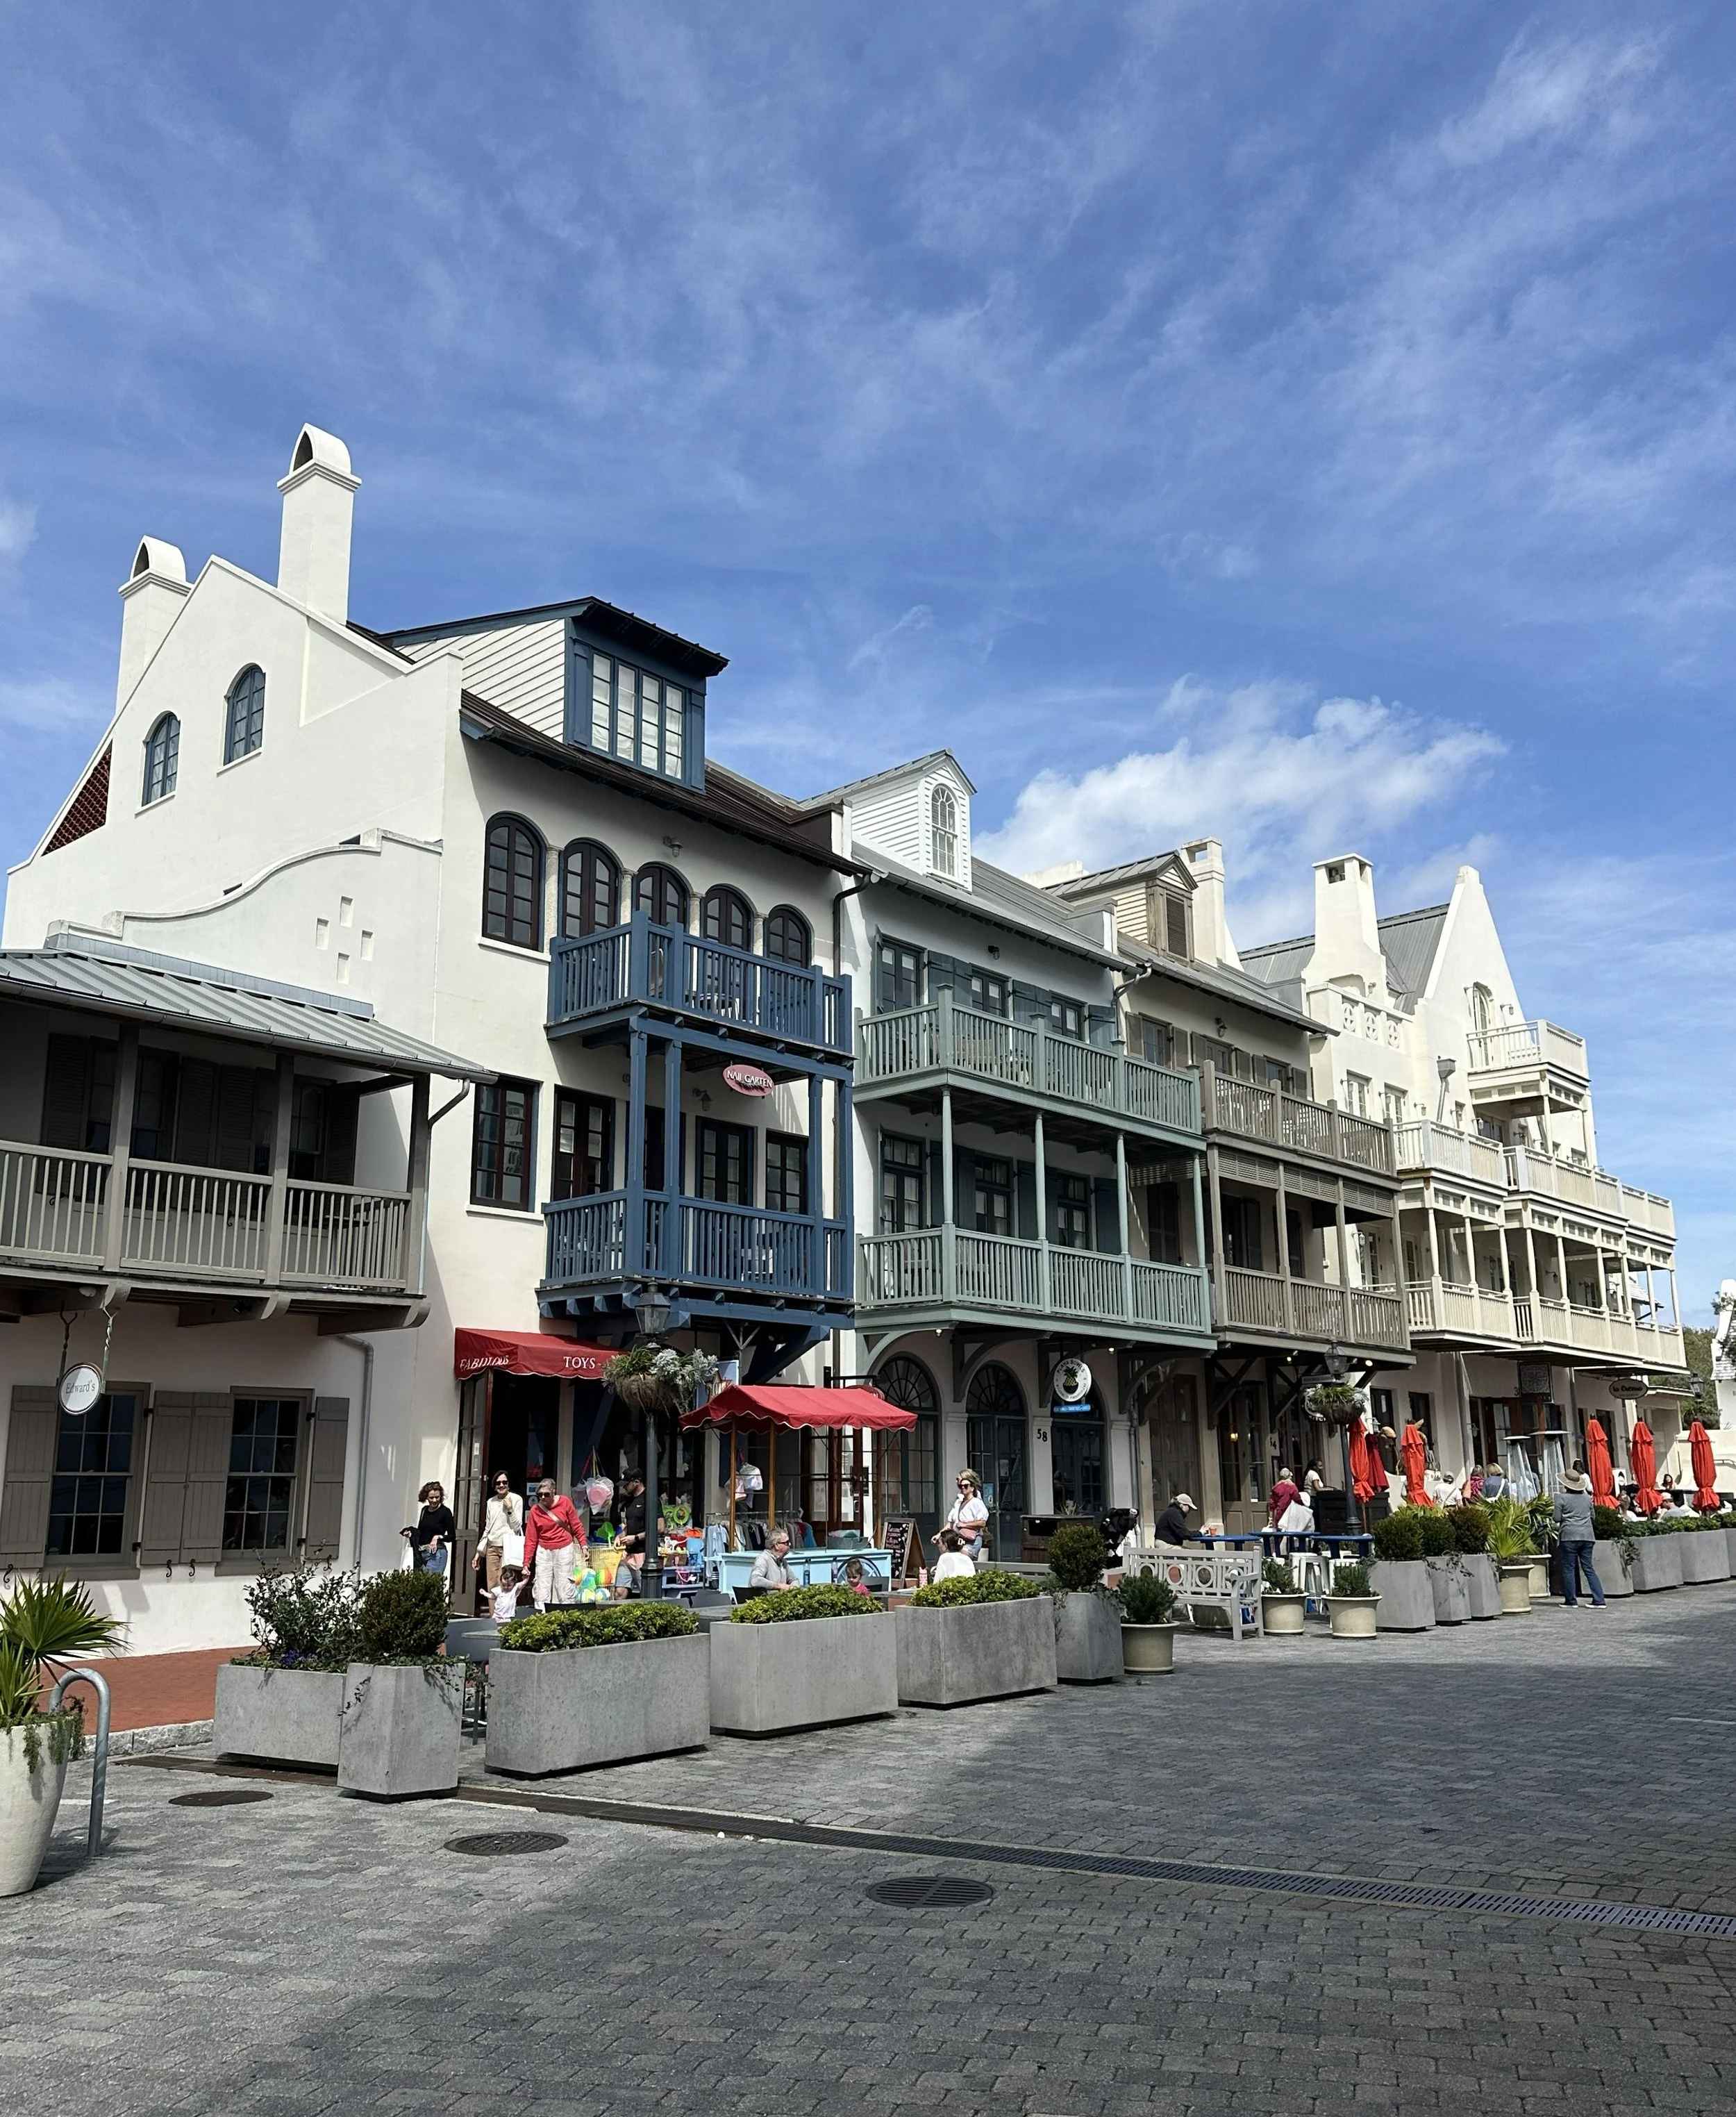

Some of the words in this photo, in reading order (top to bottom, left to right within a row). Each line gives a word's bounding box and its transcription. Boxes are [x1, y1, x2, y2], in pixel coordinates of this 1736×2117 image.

[727, 1070, 742, 1081] NAIL
[744, 1074, 772, 1088] GARTEN
[460, 1355, 509, 1371] FABULOUS
[563, 1356, 596, 1369] TOYS
[1056, 1360, 1070, 1374] PLAYA
[1070, 1359, 1085, 1373] BOWLS
[66, 1379, 96, 1394] Edward's
[1037, 1428, 1048, 1442] 58
